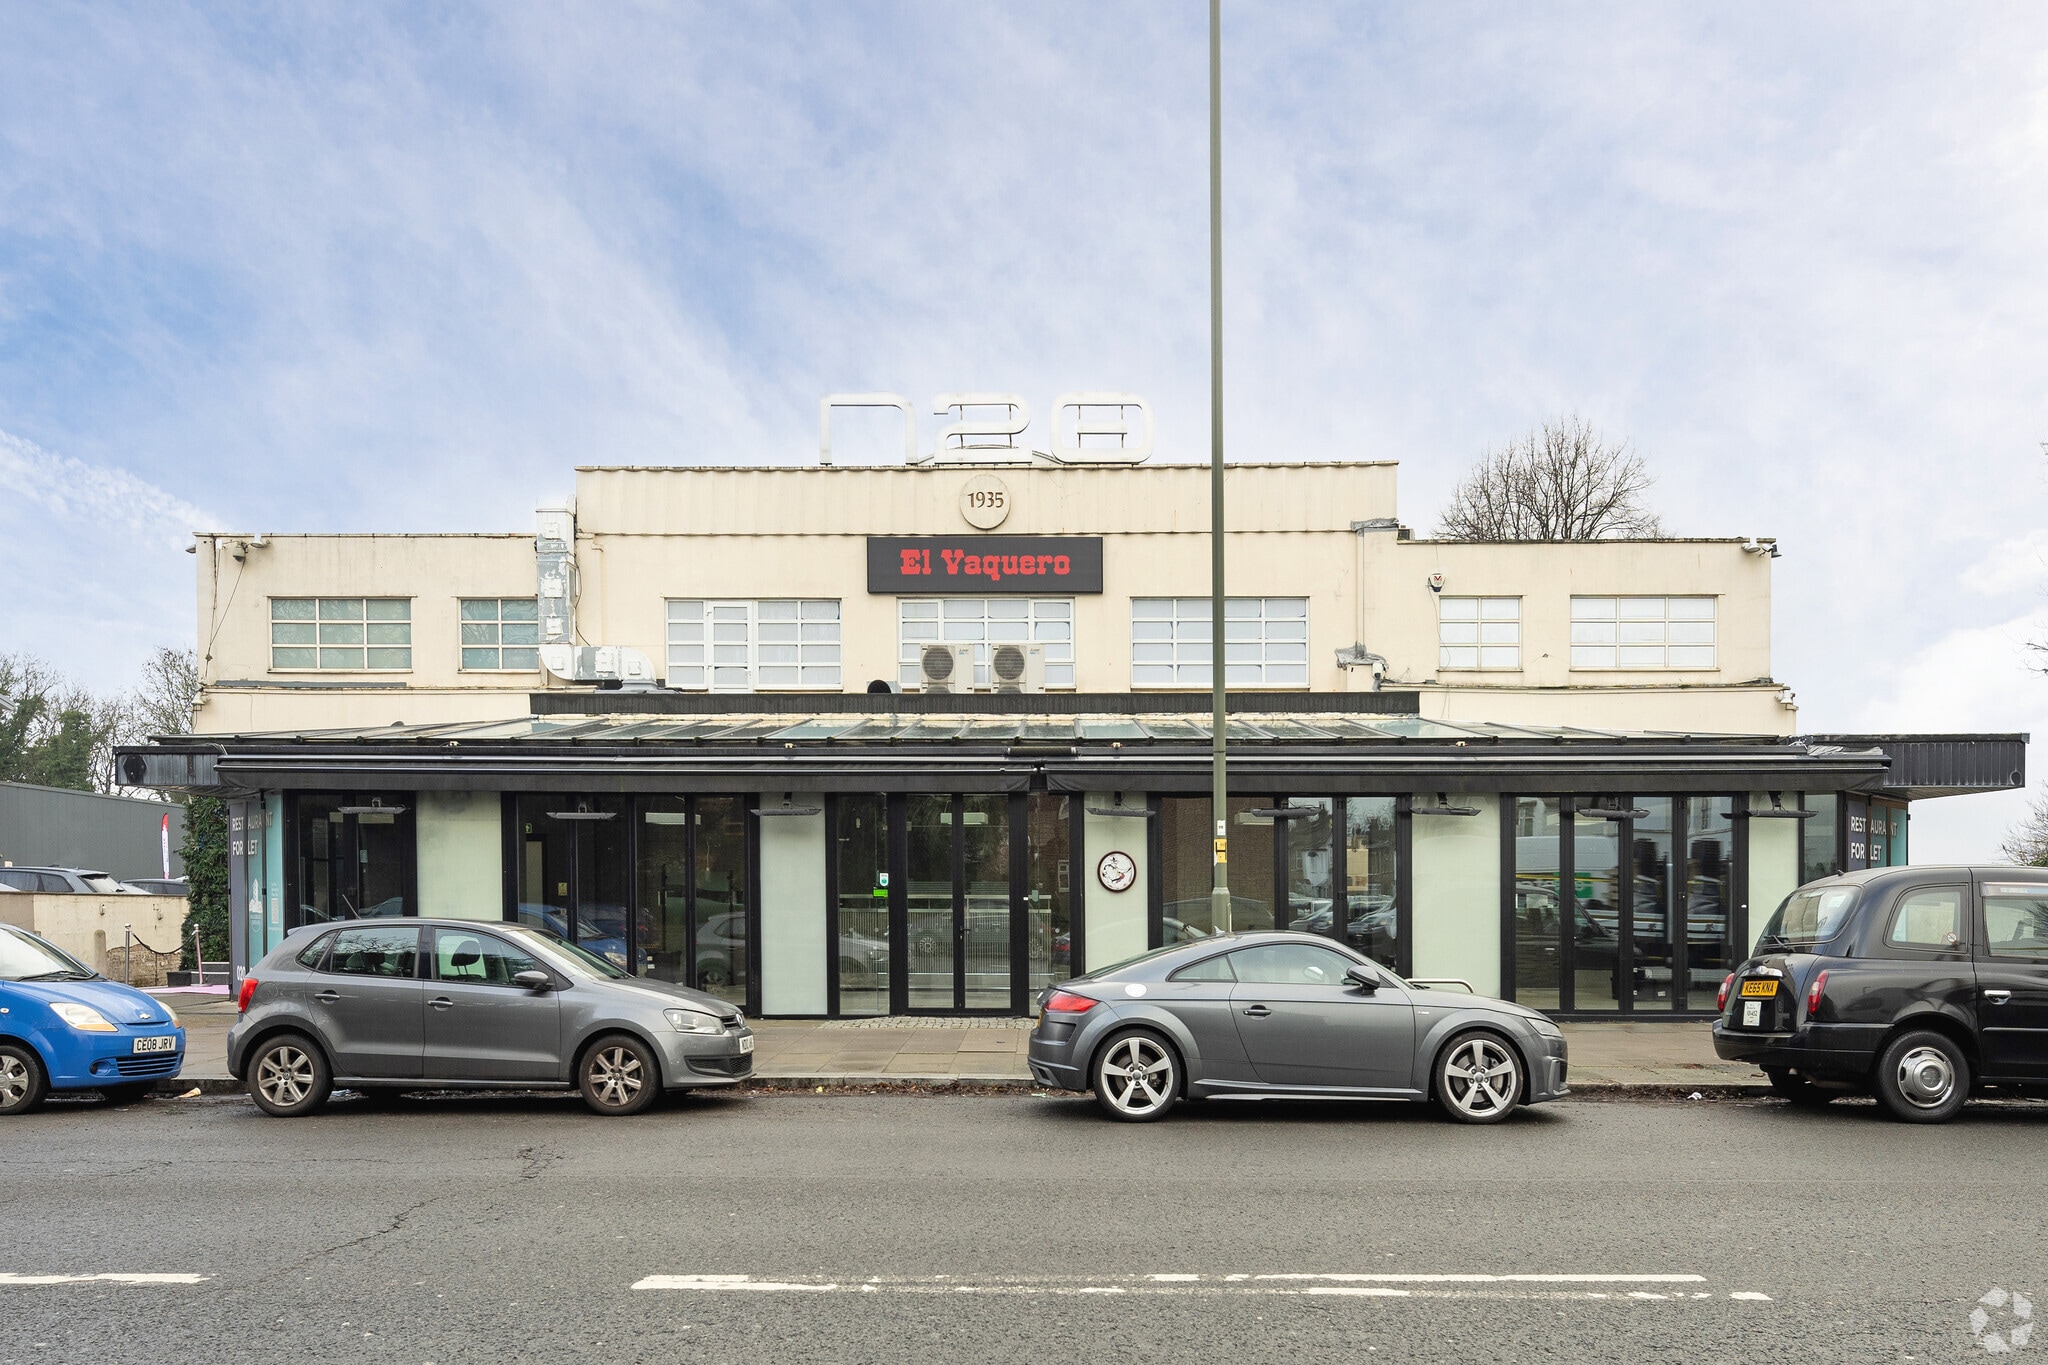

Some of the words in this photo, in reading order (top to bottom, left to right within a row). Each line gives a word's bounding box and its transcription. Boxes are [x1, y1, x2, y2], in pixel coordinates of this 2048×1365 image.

[967, 491, 1004, 508] 1935
[900, 549, 931, 575] El
[941, 549, 1071, 581] Vaquero
[232, 840, 244, 856] FOR
[248, 839, 258, 855] LET
[1851, 842, 1865, 860] FOR
[1870, 844, 1882, 861] LET
[1744, 982, 1762, 994] KE65
[1760, 982, 1775, 994] KNA
[136, 1038, 157, 1051] CE08
[158, 1036, 174, 1050] JRV
